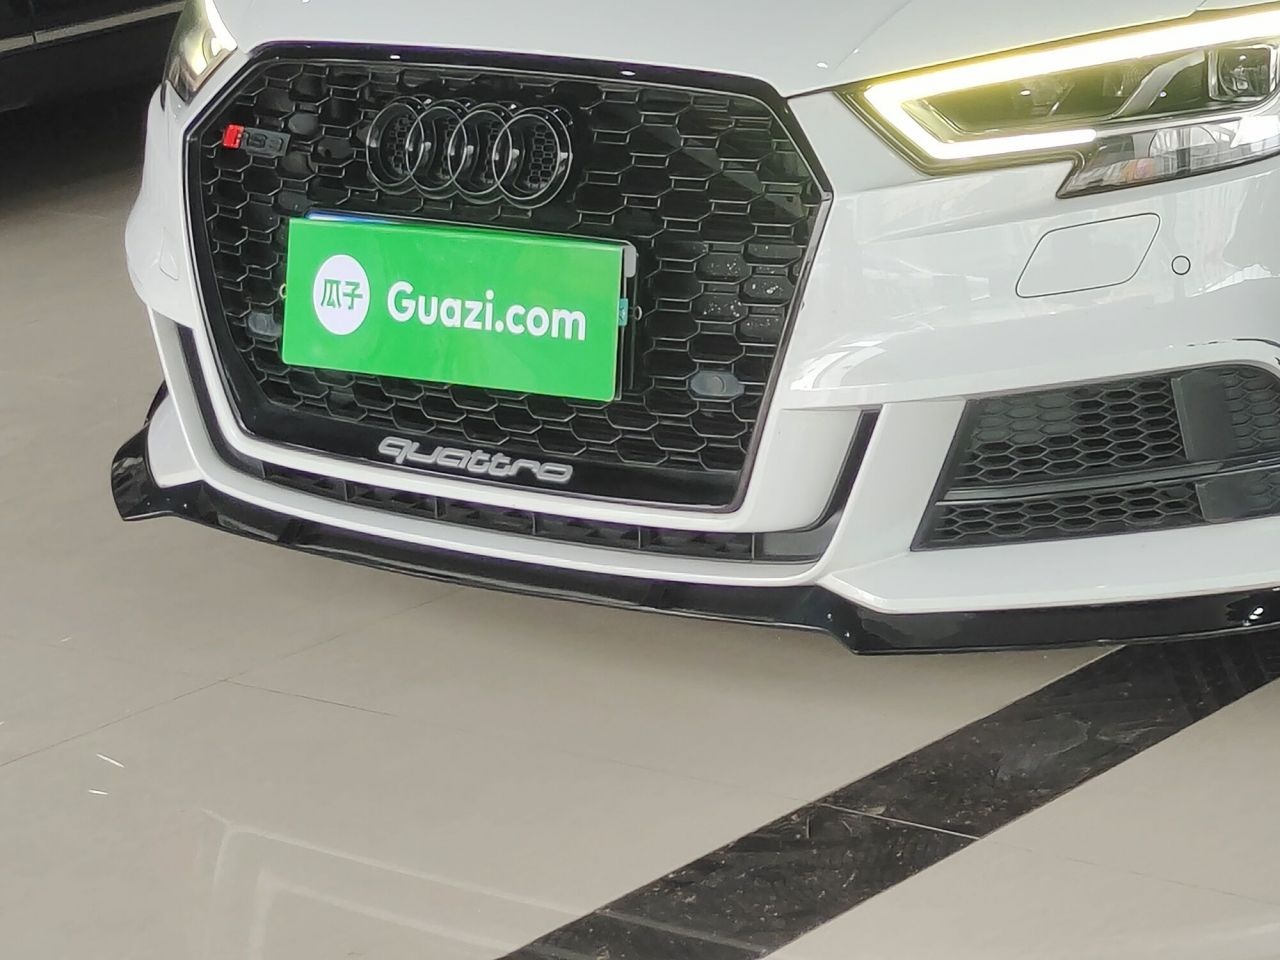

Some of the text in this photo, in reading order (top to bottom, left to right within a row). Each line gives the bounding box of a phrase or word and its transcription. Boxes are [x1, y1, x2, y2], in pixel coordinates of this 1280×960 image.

[320, 278, 364, 312] 瓜子
[387, 280, 587, 341] Guazi.com
[377, 435, 574, 484] quattro
